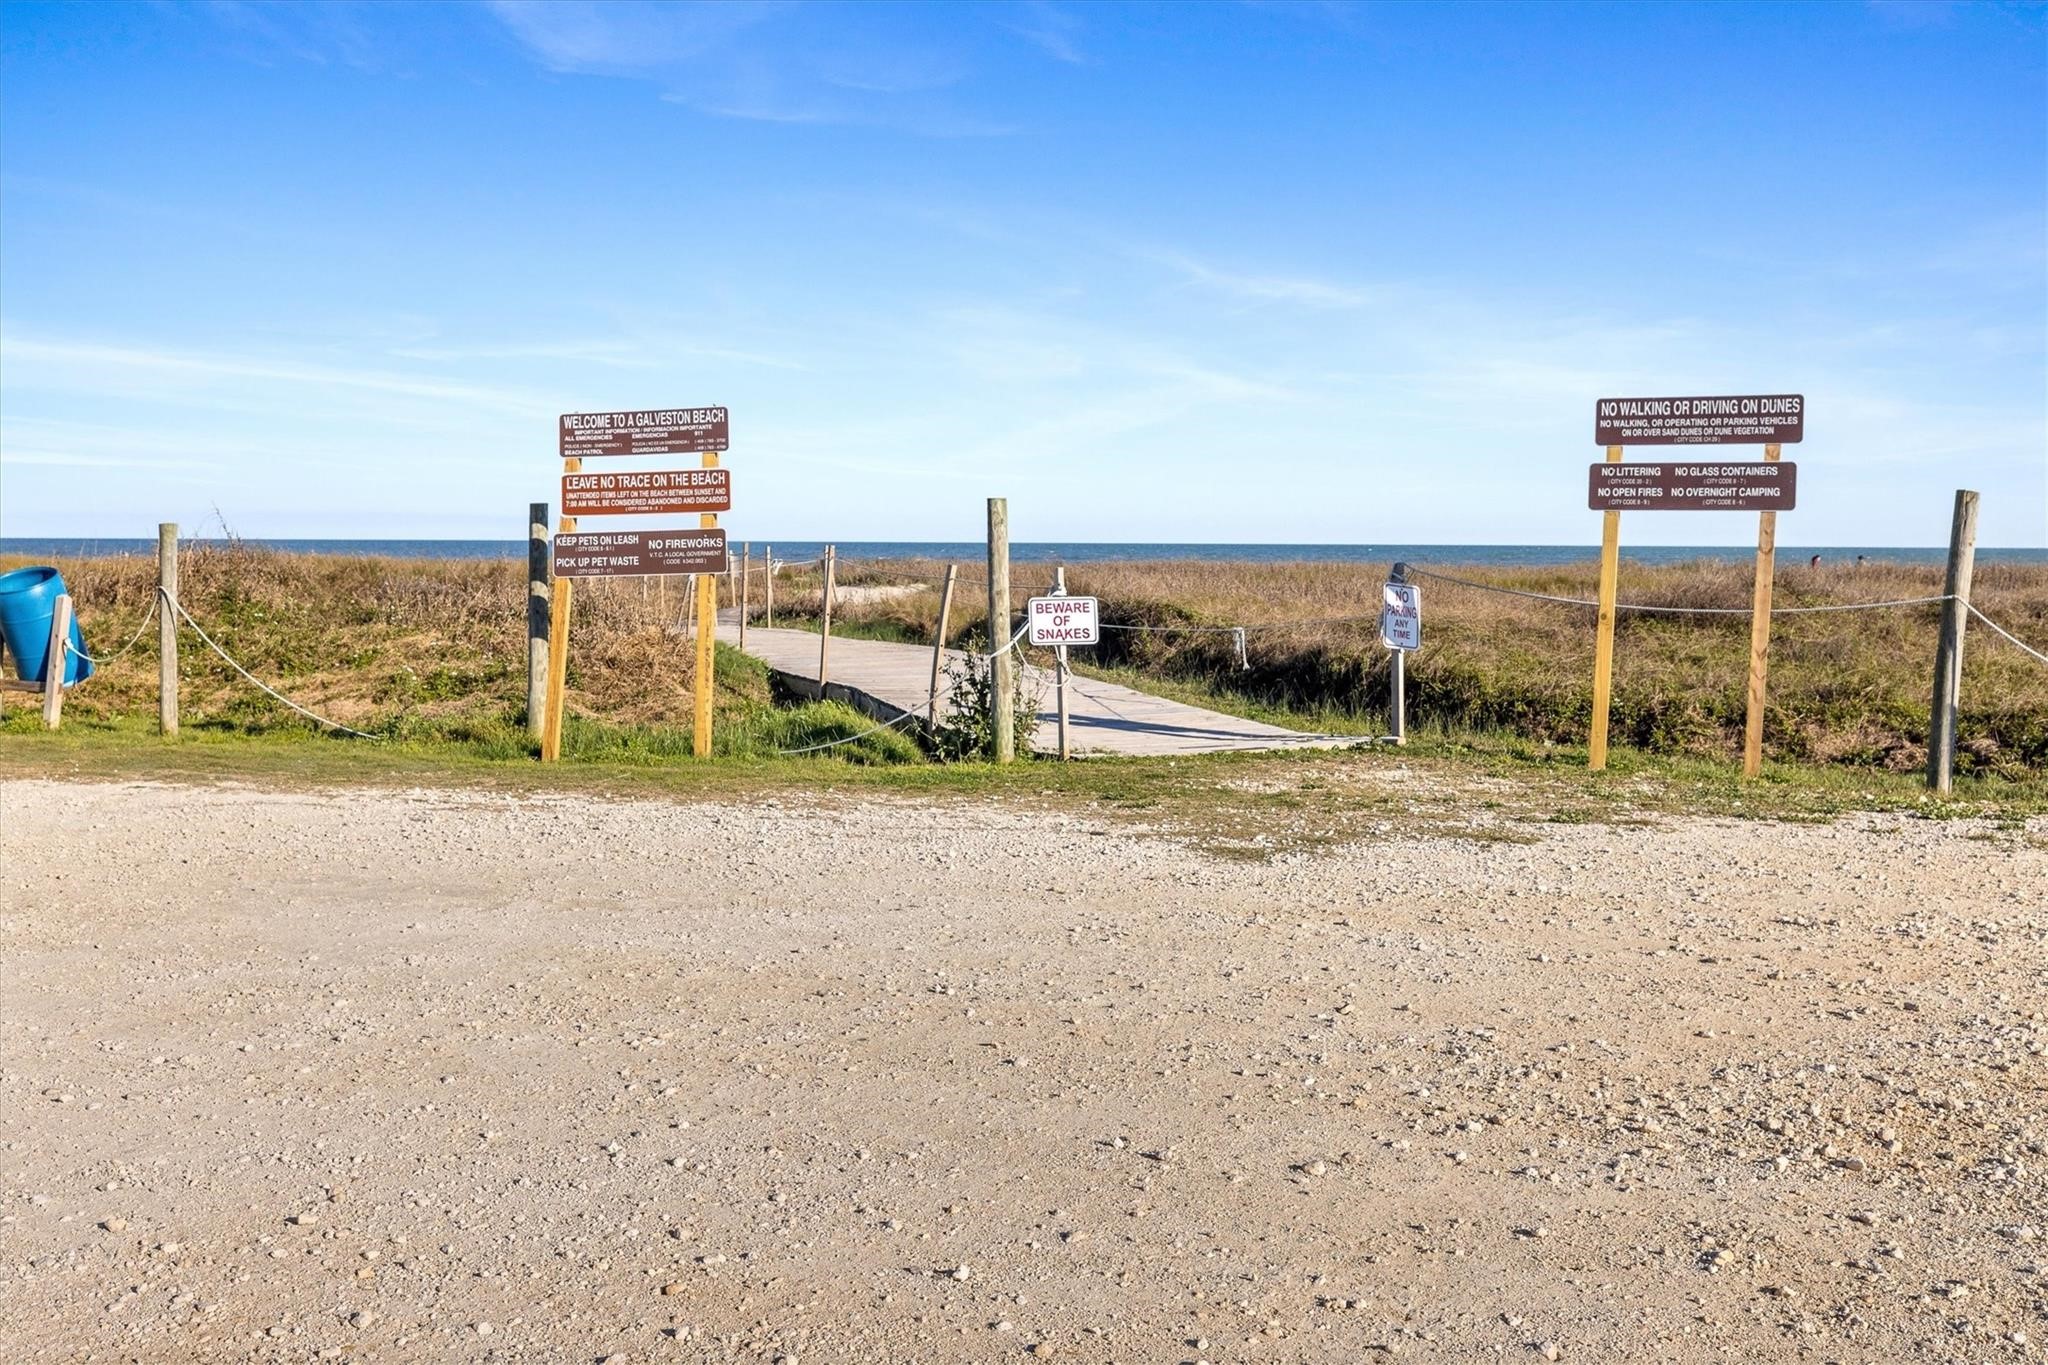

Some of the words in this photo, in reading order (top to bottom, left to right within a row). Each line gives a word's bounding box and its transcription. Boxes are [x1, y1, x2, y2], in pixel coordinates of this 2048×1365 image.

[1601, 402, 1617, 416] NO
[1619, 401, 1671, 416] WALKING
[1673, 400, 1690, 415] OR
[1693, 399, 1738, 415] DRIVING
[1741, 399, 1758, 414] ON
[1761, 398, 1800, 413] DUNES
[564, 415, 611, 429] WELCOME
[612, 414, 626, 427] TO
[627, 413, 634, 426] A
[636, 411, 690, 427] GALVESTON
[692, 409, 724, 423] BEACH
[1613, 419, 1650, 427] WALKING,
[1652, 419, 1663, 427] OR
[1664, 418, 1708, 426] OPERATING
[1710, 418, 1722, 426] OR
[1662, 428, 1679, 436] SAND
[1681, 428, 1702, 436] DUNES
[1715, 427, 1732, 435] DUNE
[1602, 467, 1615, 476] NO
[1617, 467, 1661, 476] LITTERING
[1675, 467, 1688, 476] NO
[1690, 467, 1719, 476] GLASS
[1721, 467, 1778, 476] CONTAINERS
[566, 476, 598, 489] LEAVE
[600, 476, 615, 488] NO
[617, 475, 650, 488] TRACE
[653, 474, 667, 487] ON
[670, 473, 689, 486] THE
[691, 472, 725, 485] BEACH
[630, 490, 638, 498] ON
[1598, 488, 1610, 496] NO
[1612, 488, 1636, 496] OPEN
[1638, 488, 1663, 496] FIRES
[1671, 488, 1684, 496] NO
[1686, 488, 1737, 496] OVERNIGHT
[1739, 488, 1780, 496] CAMPING
[648, 497, 682, 505] ABANDONED
[556, 536, 577, 546] KEEP
[579, 536, 598, 546] PETS
[600, 536, 612, 545] ON
[613, 534, 639, 545] LEASH
[648, 540, 663, 549] NO
[665, 538, 723, 549] FIREWORKS
[556, 558, 576, 568] PICK
[578, 558, 590, 567] UP
[592, 557, 608, 567] PET
[609, 556, 639, 566] WASTE
[1395, 590, 1409, 603] NO
[1036, 602, 1090, 614] BEWARE
[1388, 604, 1417, 619] PARKING
[1053, 616, 1070, 626] OF
[1394, 619, 1408, 628] ANY
[1037, 628, 1090, 639] SNAKES
[1393, 629, 1411, 639] TIME
